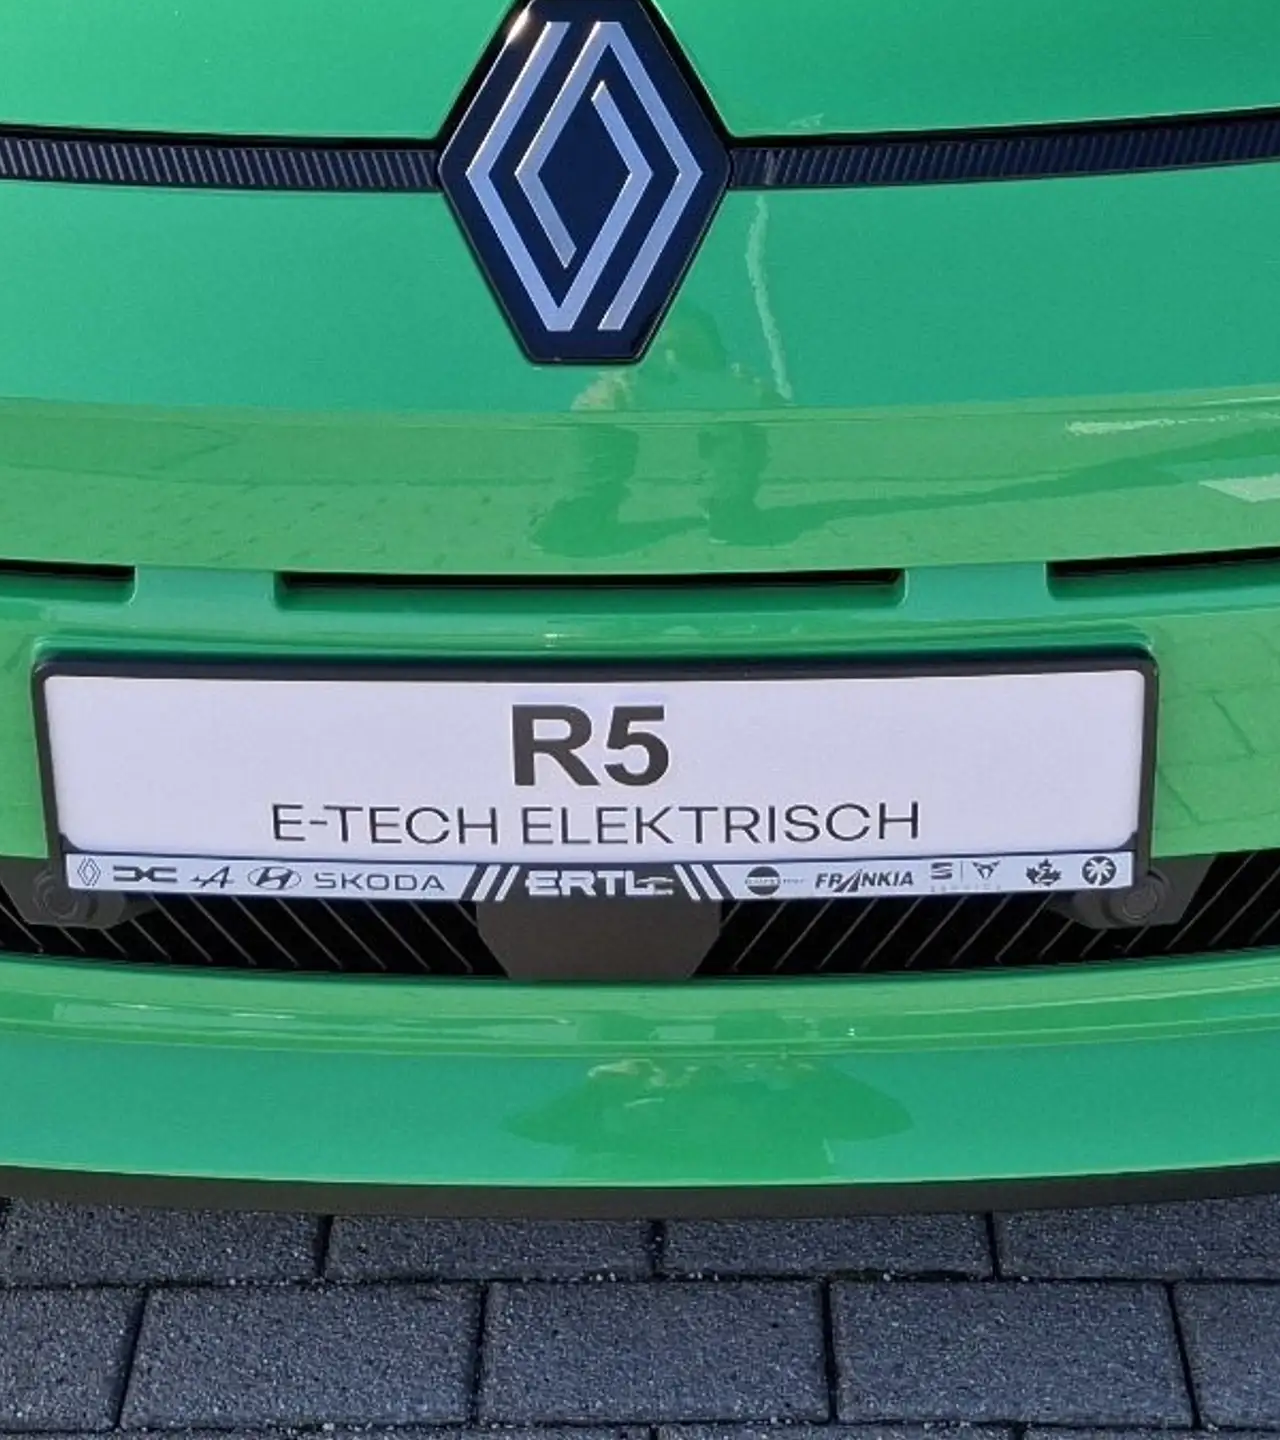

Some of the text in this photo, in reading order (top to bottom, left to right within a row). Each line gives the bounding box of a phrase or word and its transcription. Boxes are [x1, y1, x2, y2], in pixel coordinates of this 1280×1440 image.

[512, 703, 670, 787] R5
[271, 800, 920, 846] E-TECH ELEKTRISCH
[524, 868, 660, 897] ERTL
[814, 867, 915, 893] FRANKIA
